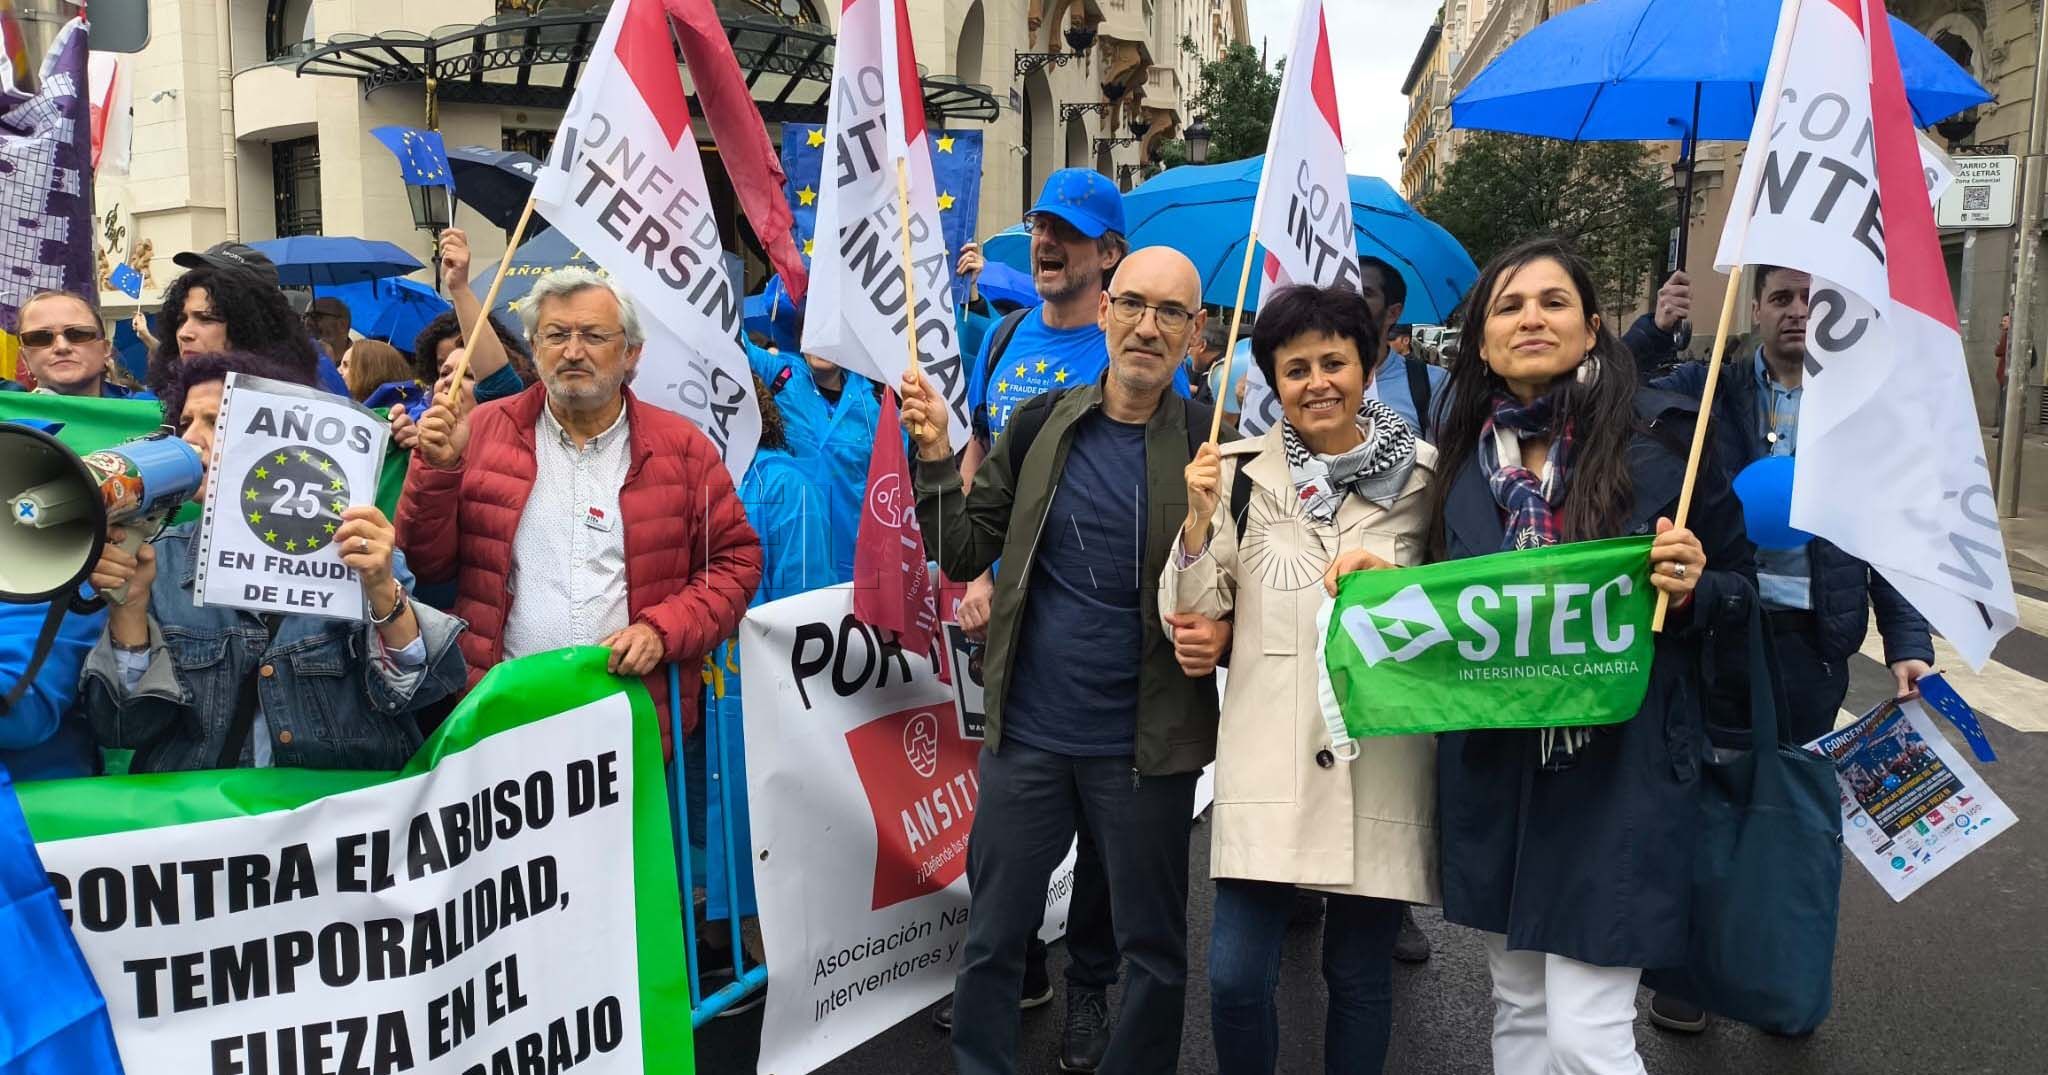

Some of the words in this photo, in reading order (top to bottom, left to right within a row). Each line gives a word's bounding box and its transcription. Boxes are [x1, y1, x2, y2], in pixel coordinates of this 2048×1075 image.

[1972, 169, 2001, 177] LETRAS
[1009, 384, 1036, 394] FRAUDE
[245, 404, 372, 454] AÑOS
[269, 478, 324, 519] 25
[218, 550, 255, 570] EN
[264, 555, 358, 583] FRAUDE
[243, 584, 278, 603] DE
[286, 588, 334, 609] LEY
[1457, 574, 1635, 662] STEC
[1459, 664, 1569, 681] INTERSINDICAL
[1572, 661, 1639, 676] CANARIA
[336, 829, 396, 893] EL
[407, 770, 555, 881] ABUSO
[566, 750, 619, 818] DE
[123, 855, 570, 1020] TEMPORALIDAD,
[814, 921, 931, 986] Asociación
[815, 949, 941, 1022] Interventores
[946, 941, 960, 962] y
[427, 977, 476, 1061] EN
[485, 953, 528, 1027] EL
